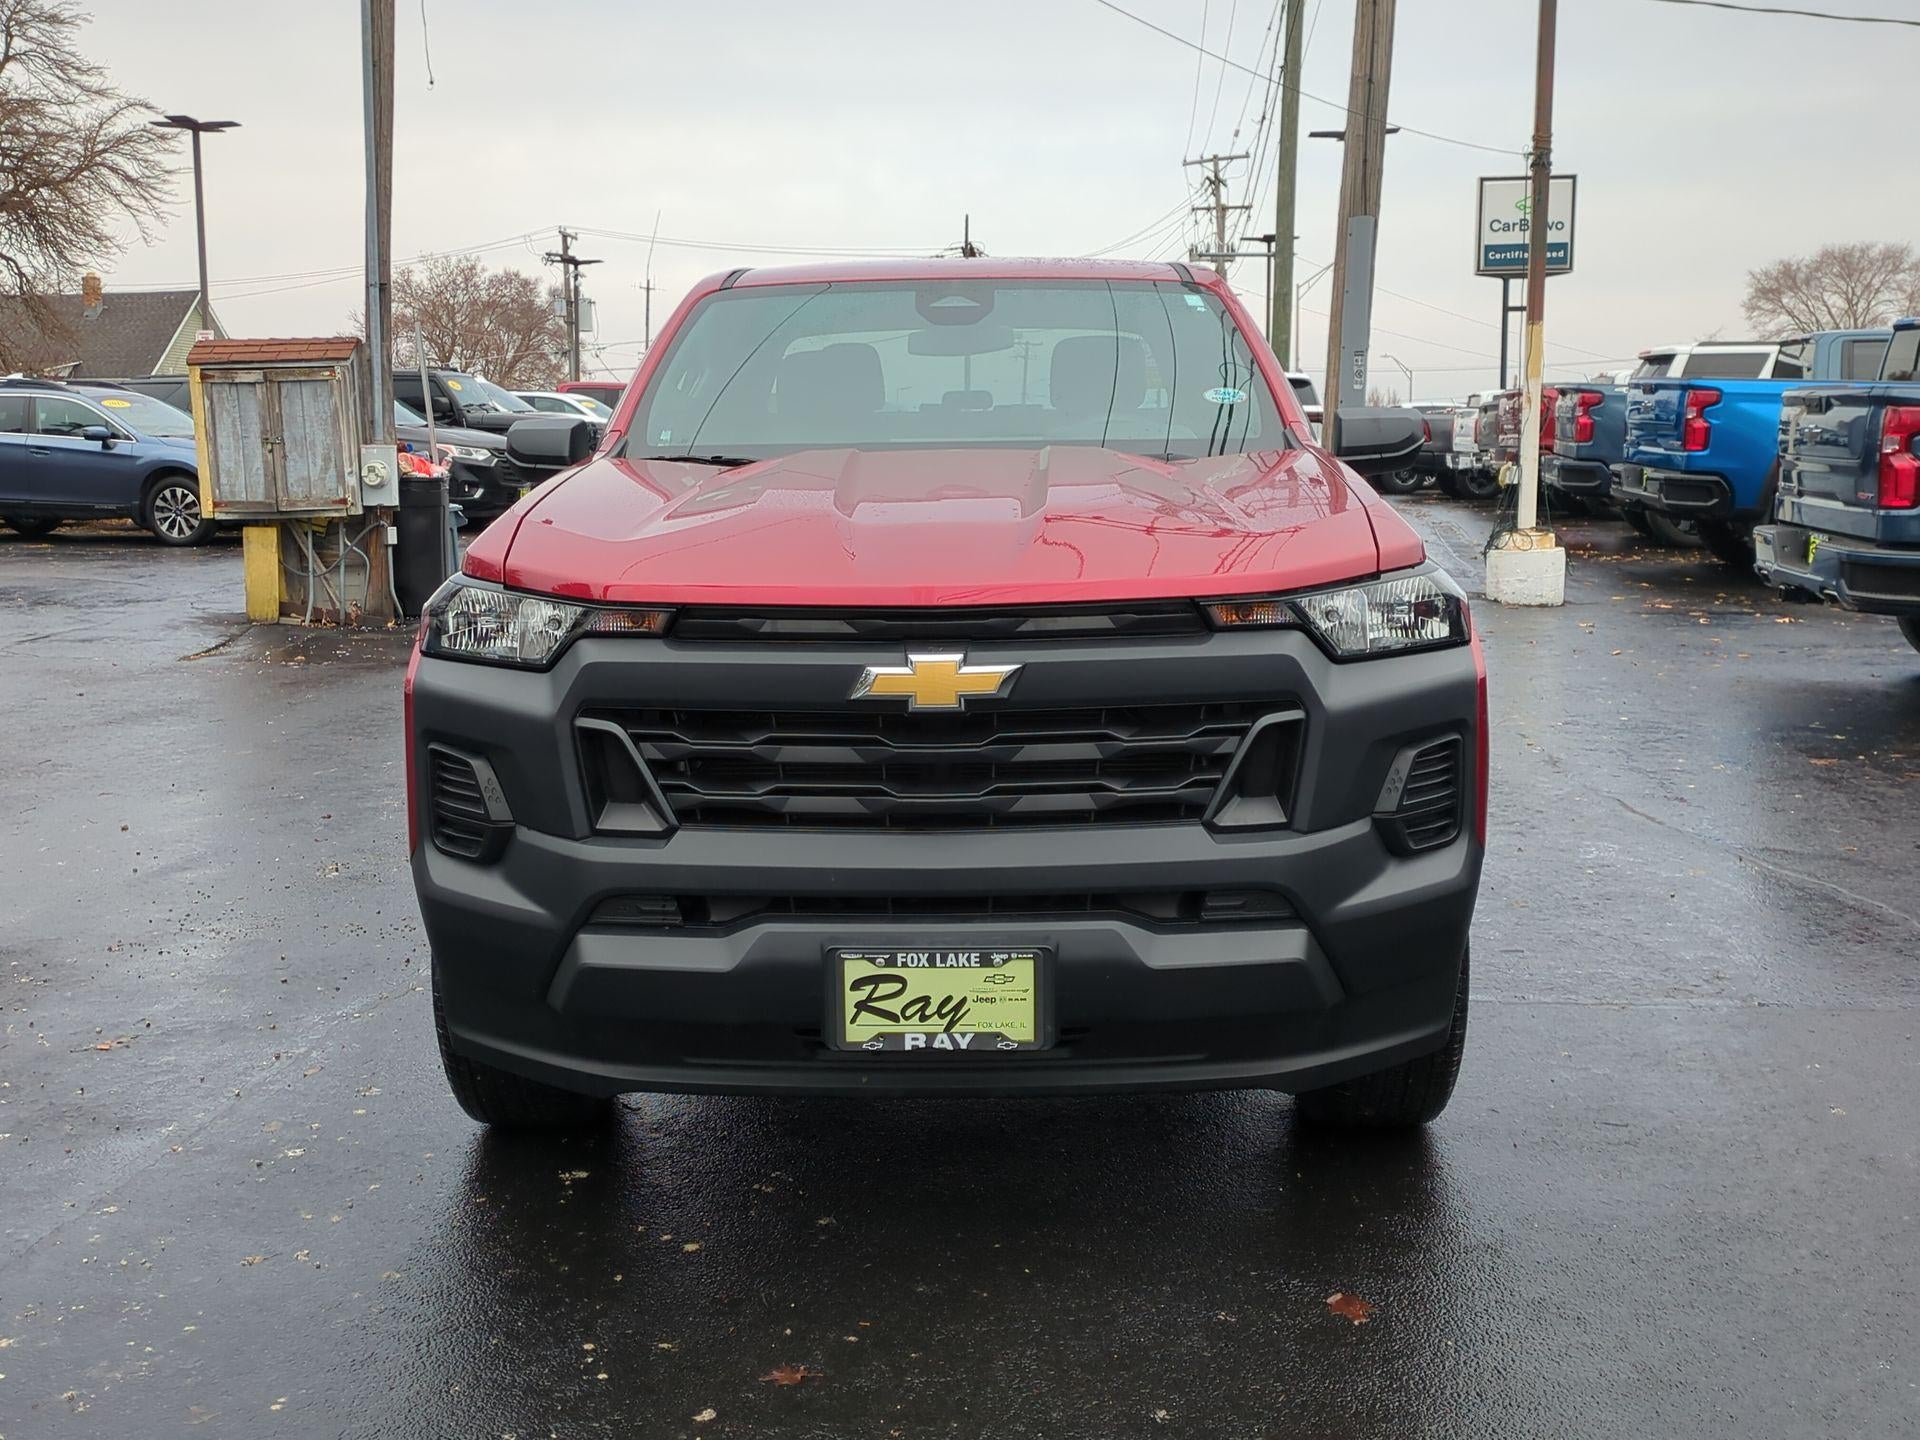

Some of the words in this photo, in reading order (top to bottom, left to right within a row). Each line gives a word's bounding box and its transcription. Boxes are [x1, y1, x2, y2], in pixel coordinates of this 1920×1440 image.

[1490, 219, 1564, 232] CarBvo
[1489, 251, 1529, 259] Certifie
[896, 952, 930, 967] FOX
[936, 952, 981, 967] LAKE
[850, 974, 971, 1032] Ray
[972, 995, 997, 1004] Jeep
[904, 1033, 975, 1050] RAY
